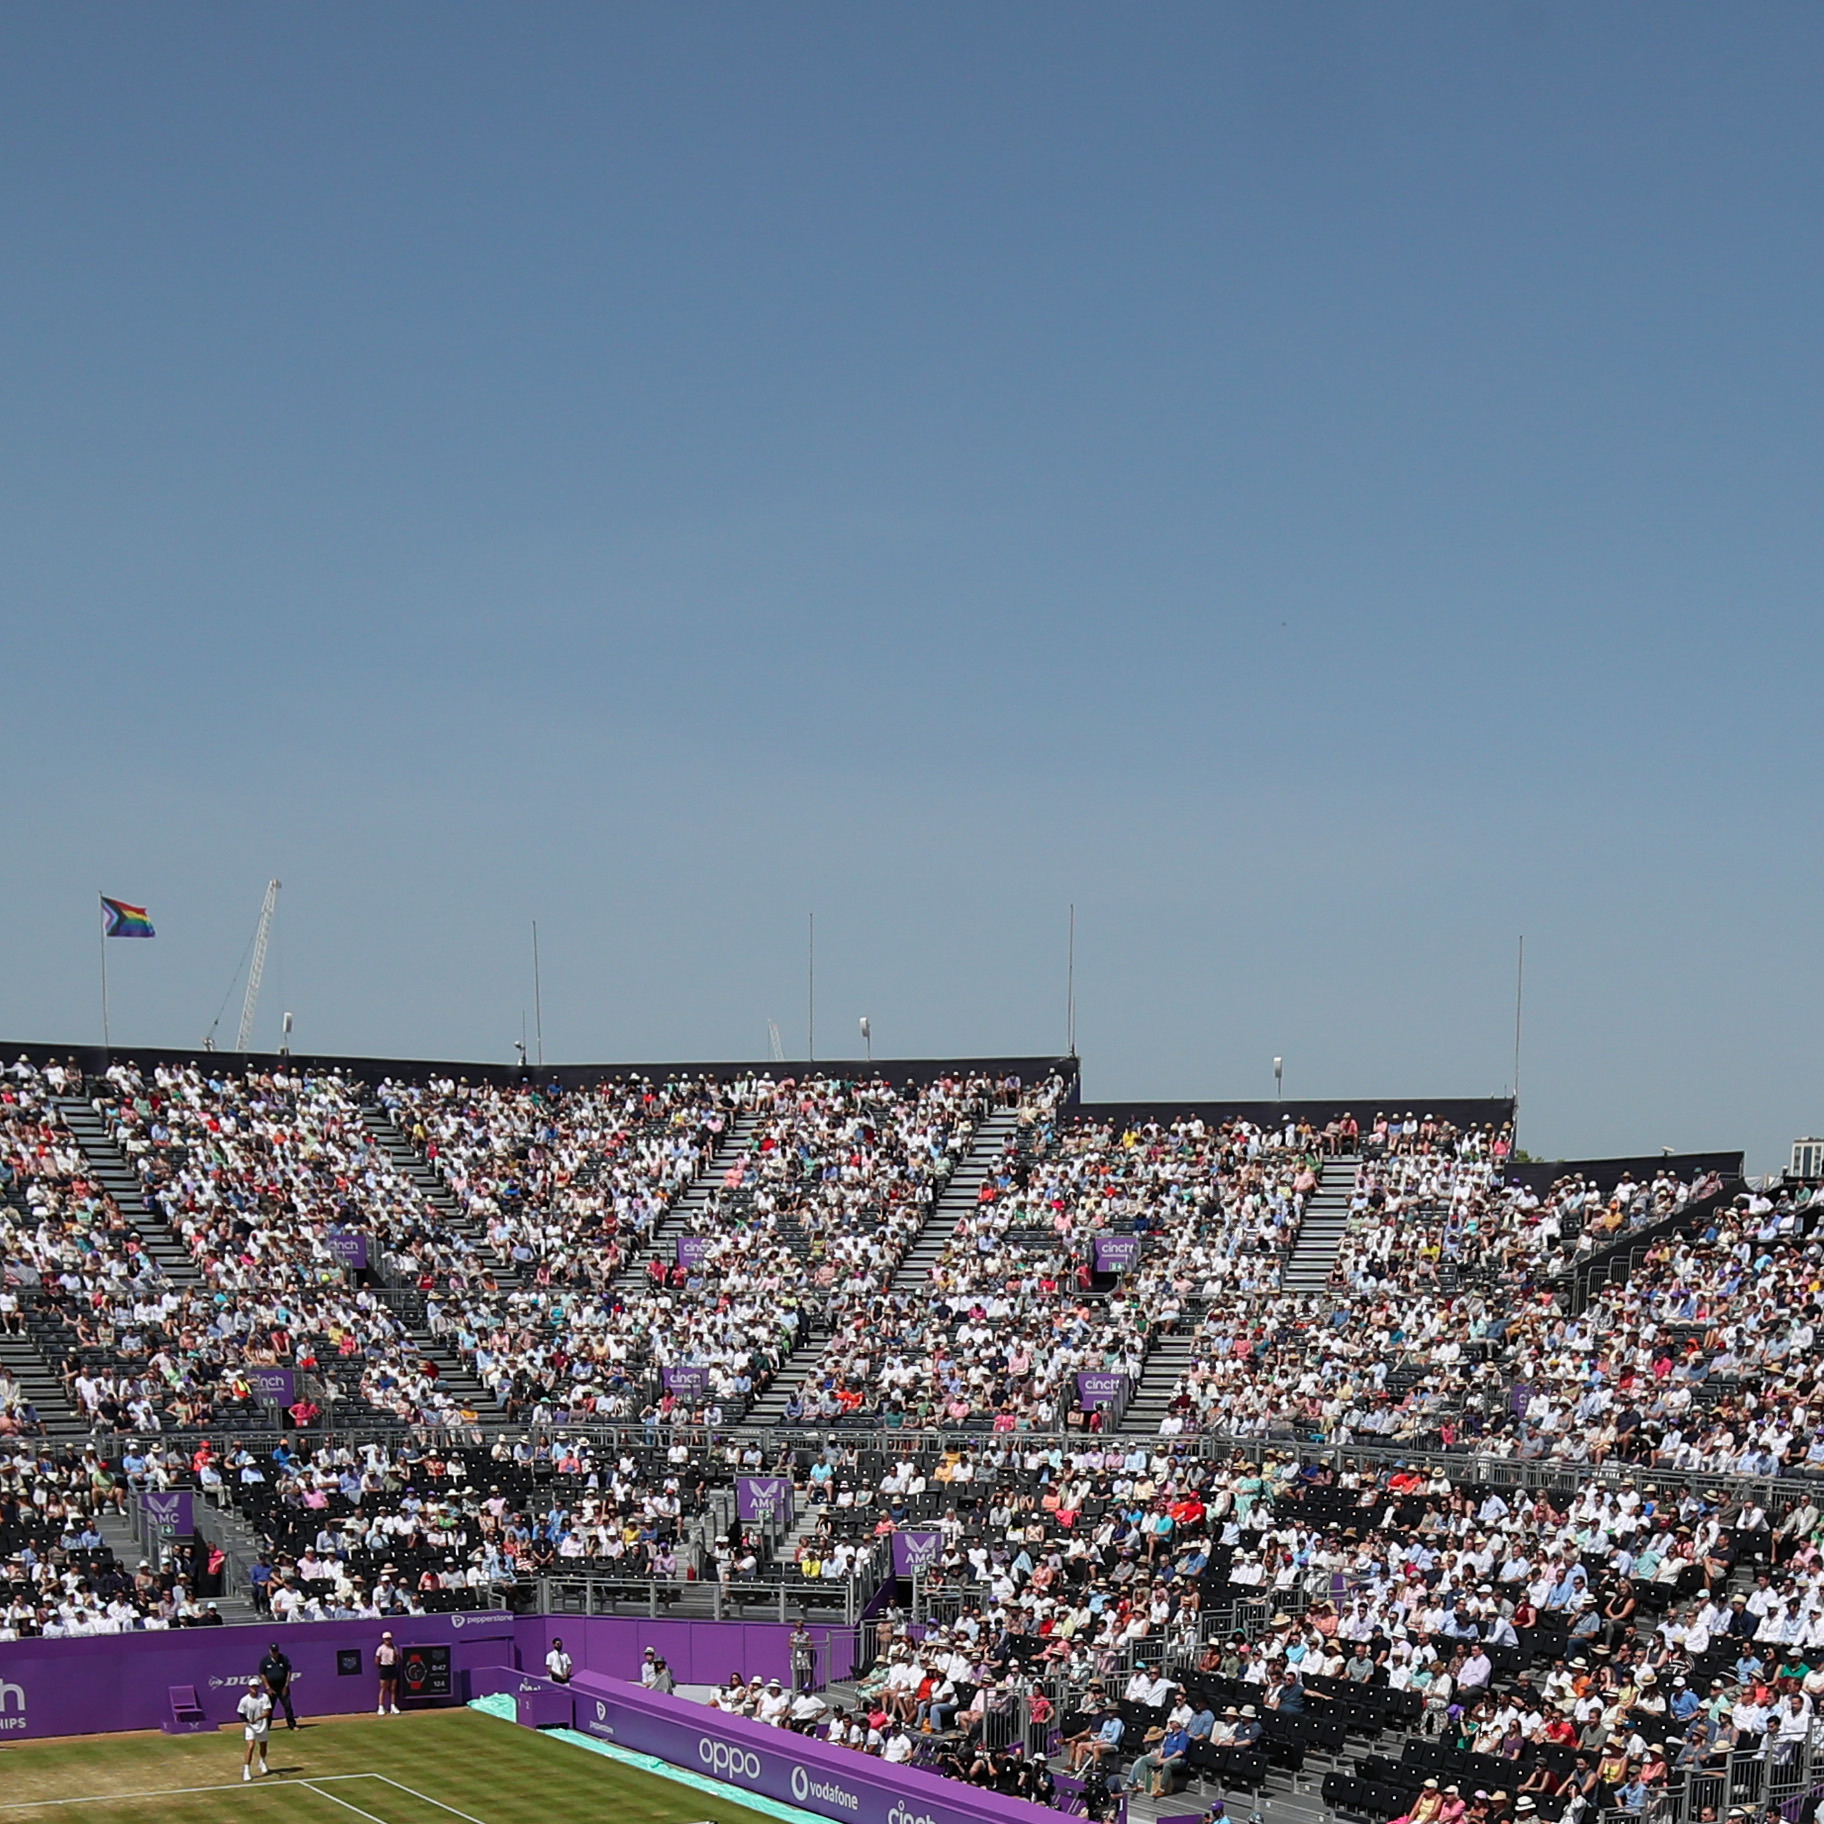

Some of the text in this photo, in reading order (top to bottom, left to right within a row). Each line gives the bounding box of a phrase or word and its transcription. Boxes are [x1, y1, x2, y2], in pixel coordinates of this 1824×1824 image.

[467, 1614, 514, 1624] pepperstone
[699, 1737, 761, 1780] oppo
[810, 1779, 858, 1811] vodafone
